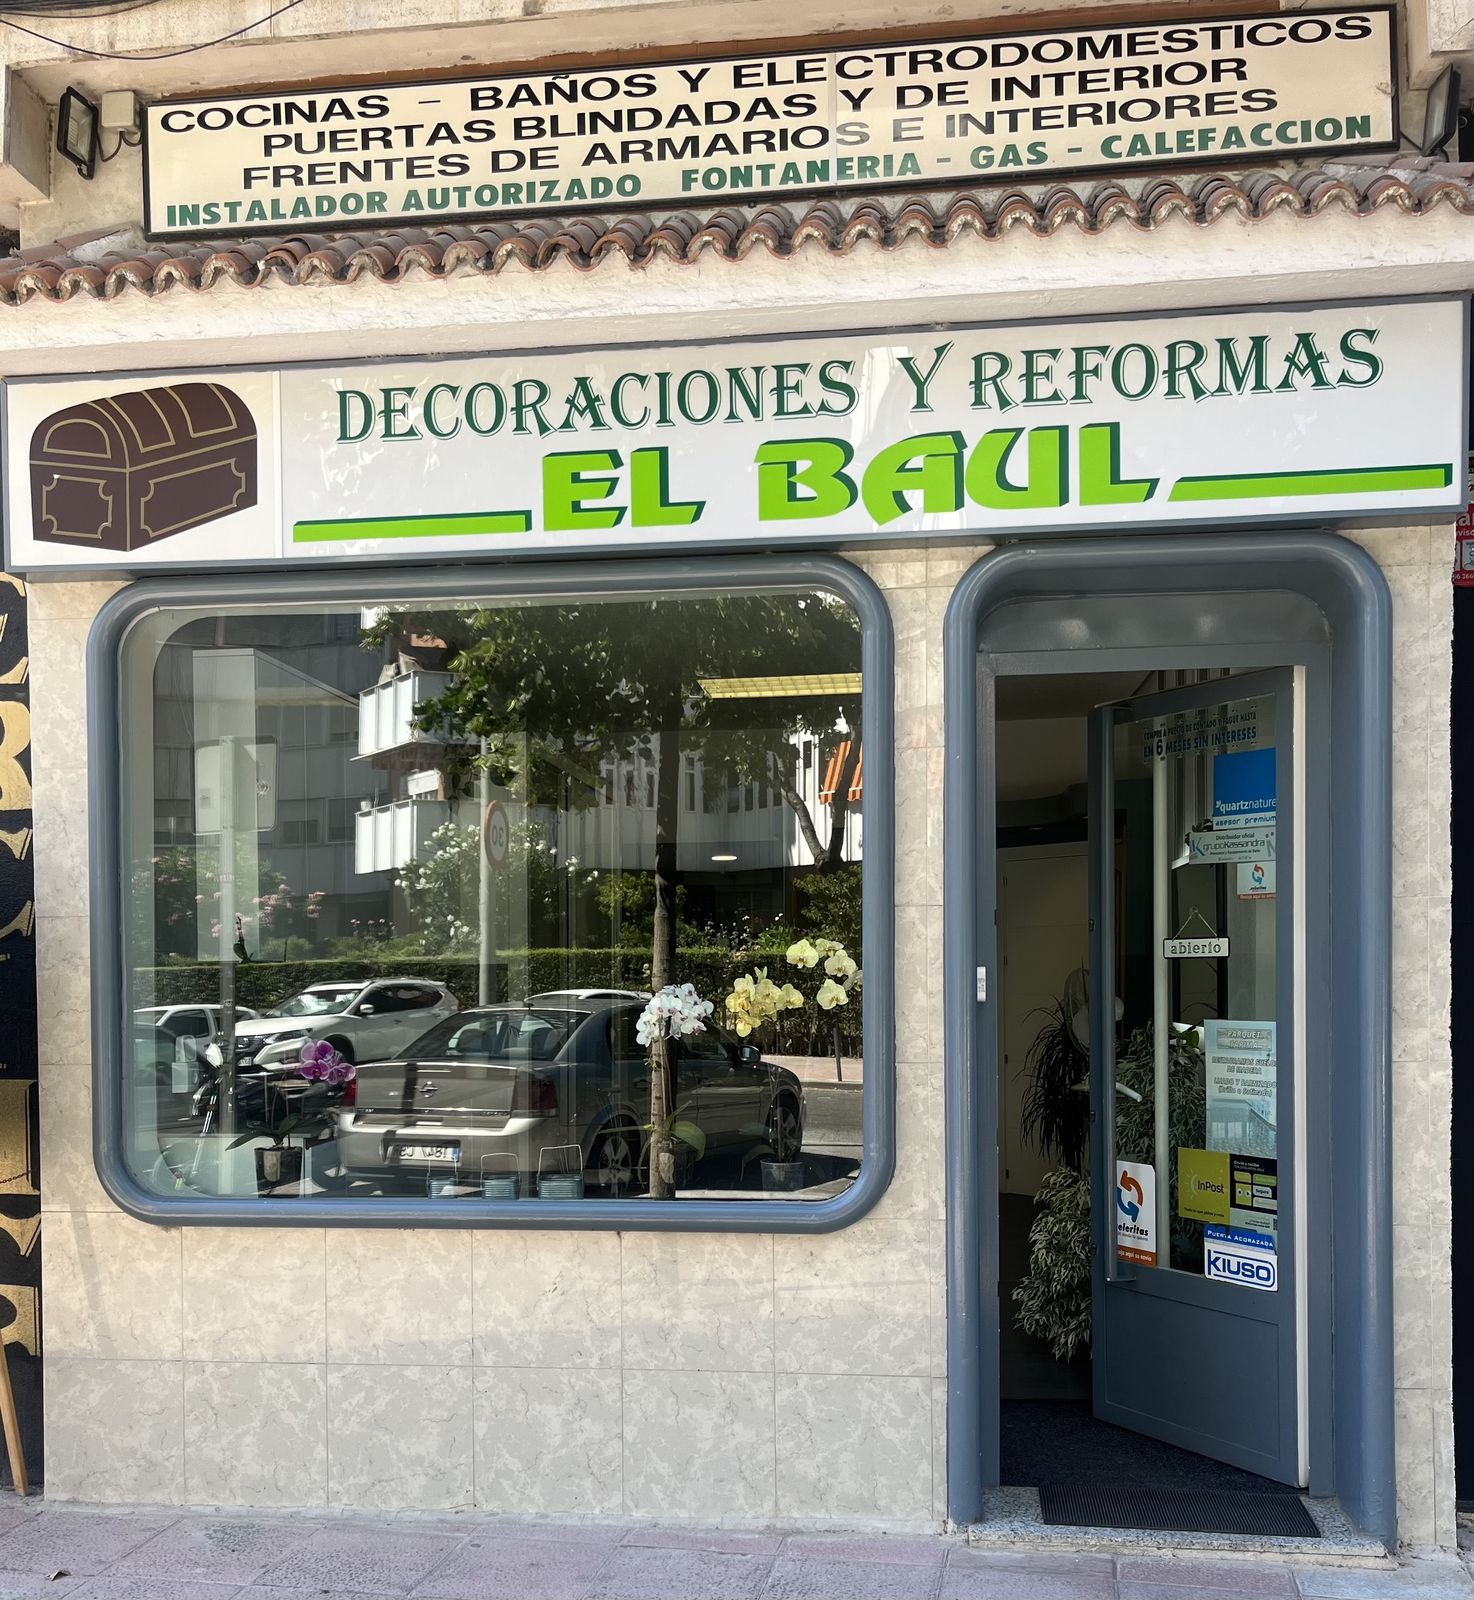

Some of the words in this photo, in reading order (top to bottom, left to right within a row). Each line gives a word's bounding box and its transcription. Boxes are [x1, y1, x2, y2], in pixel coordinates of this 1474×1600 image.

[160, 95, 390, 133] COCINAS
[470, 74, 657, 112] BAÑOS
[678, 68, 715, 94] Y
[734, 15, 1373, 90] ELECTRODOMESTICOS
[263, 118, 497, 158] PUERTAS
[513, 92, 817, 142] BLINDADAS
[840, 87, 873, 113] Y
[903, 79, 970, 109] DE
[990, 57, 1248, 102] INTERIOR
[243, 153, 470, 191] FRENTES
[491, 146, 560, 174] DE
[581, 120, 870, 168] ARMARIOS
[892, 117, 922, 143] E
[944, 88, 1279, 139] INTERIORES
[166, 191, 387, 228] INSTALADOR
[401, 173, 643, 214] AUTORIZADO
[682, 151, 920, 192] FONTANERIA
[970, 140, 1049, 170] GAS
[1100, 115, 1372, 160] CALEFACCION
[335, 358, 860, 445] DECORACIONES
[896, 340, 956, 413] Y
[969, 328, 1383, 413] REFORMAS
[542, 445, 707, 532] EL
[754, 421, 1160, 526] BAUL
[1168, 725, 1185, 737] PRECIO
[1240, 711, 1257, 722] HASTA
[1144, 745, 1154, 758] EN
[1156, 738, 1164, 756] 6
[1166, 739, 1191, 754] MESES
[1194, 733, 1209, 749] SIN
[1211, 726, 1257, 746] INTERESES
[1216, 818, 1240, 827] asesor
[1170, 941, 1222, 955] abierto
[1197, 1179, 1225, 1194] InPost
[1118, 1223, 1149, 1236] eleritas
[1208, 1249, 1271, 1282] KIUSO
